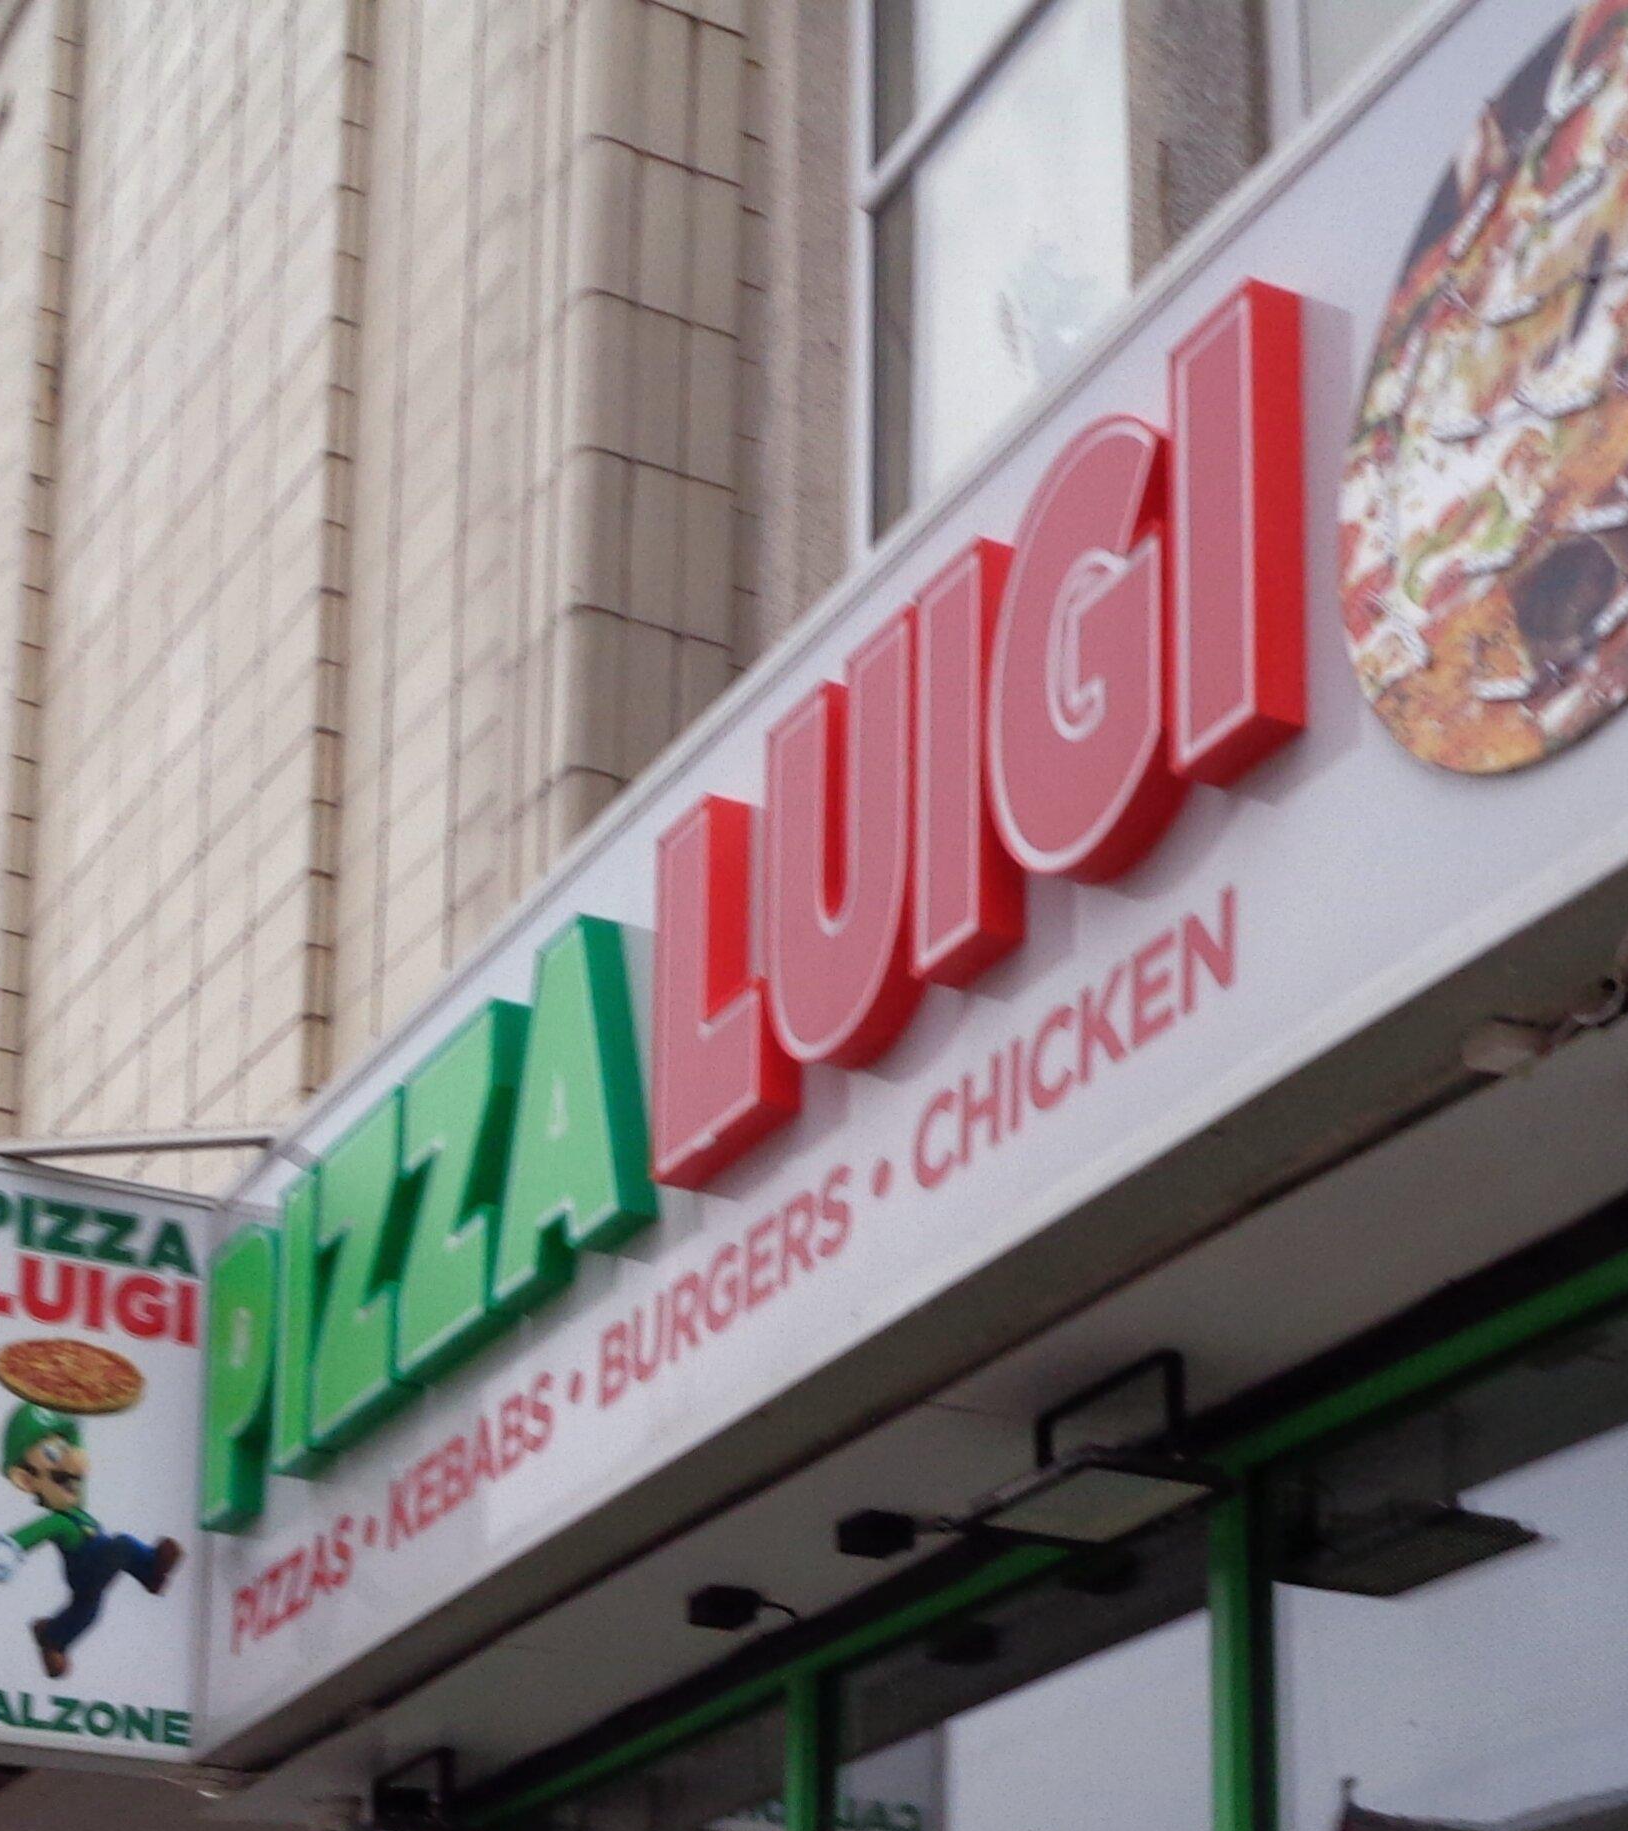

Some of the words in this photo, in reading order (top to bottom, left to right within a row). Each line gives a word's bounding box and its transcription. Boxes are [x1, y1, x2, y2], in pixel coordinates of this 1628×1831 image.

[200, 912, 659, 1531] PIZZA
[652, 278, 1303, 1189] LUIGI
[228, 1517, 356, 1654] PIZZAS
[383, 1370, 556, 1552] KEBABS
[597, 1164, 853, 1410] BURGERS
[911, 886, 1238, 1194] CHICKEN
